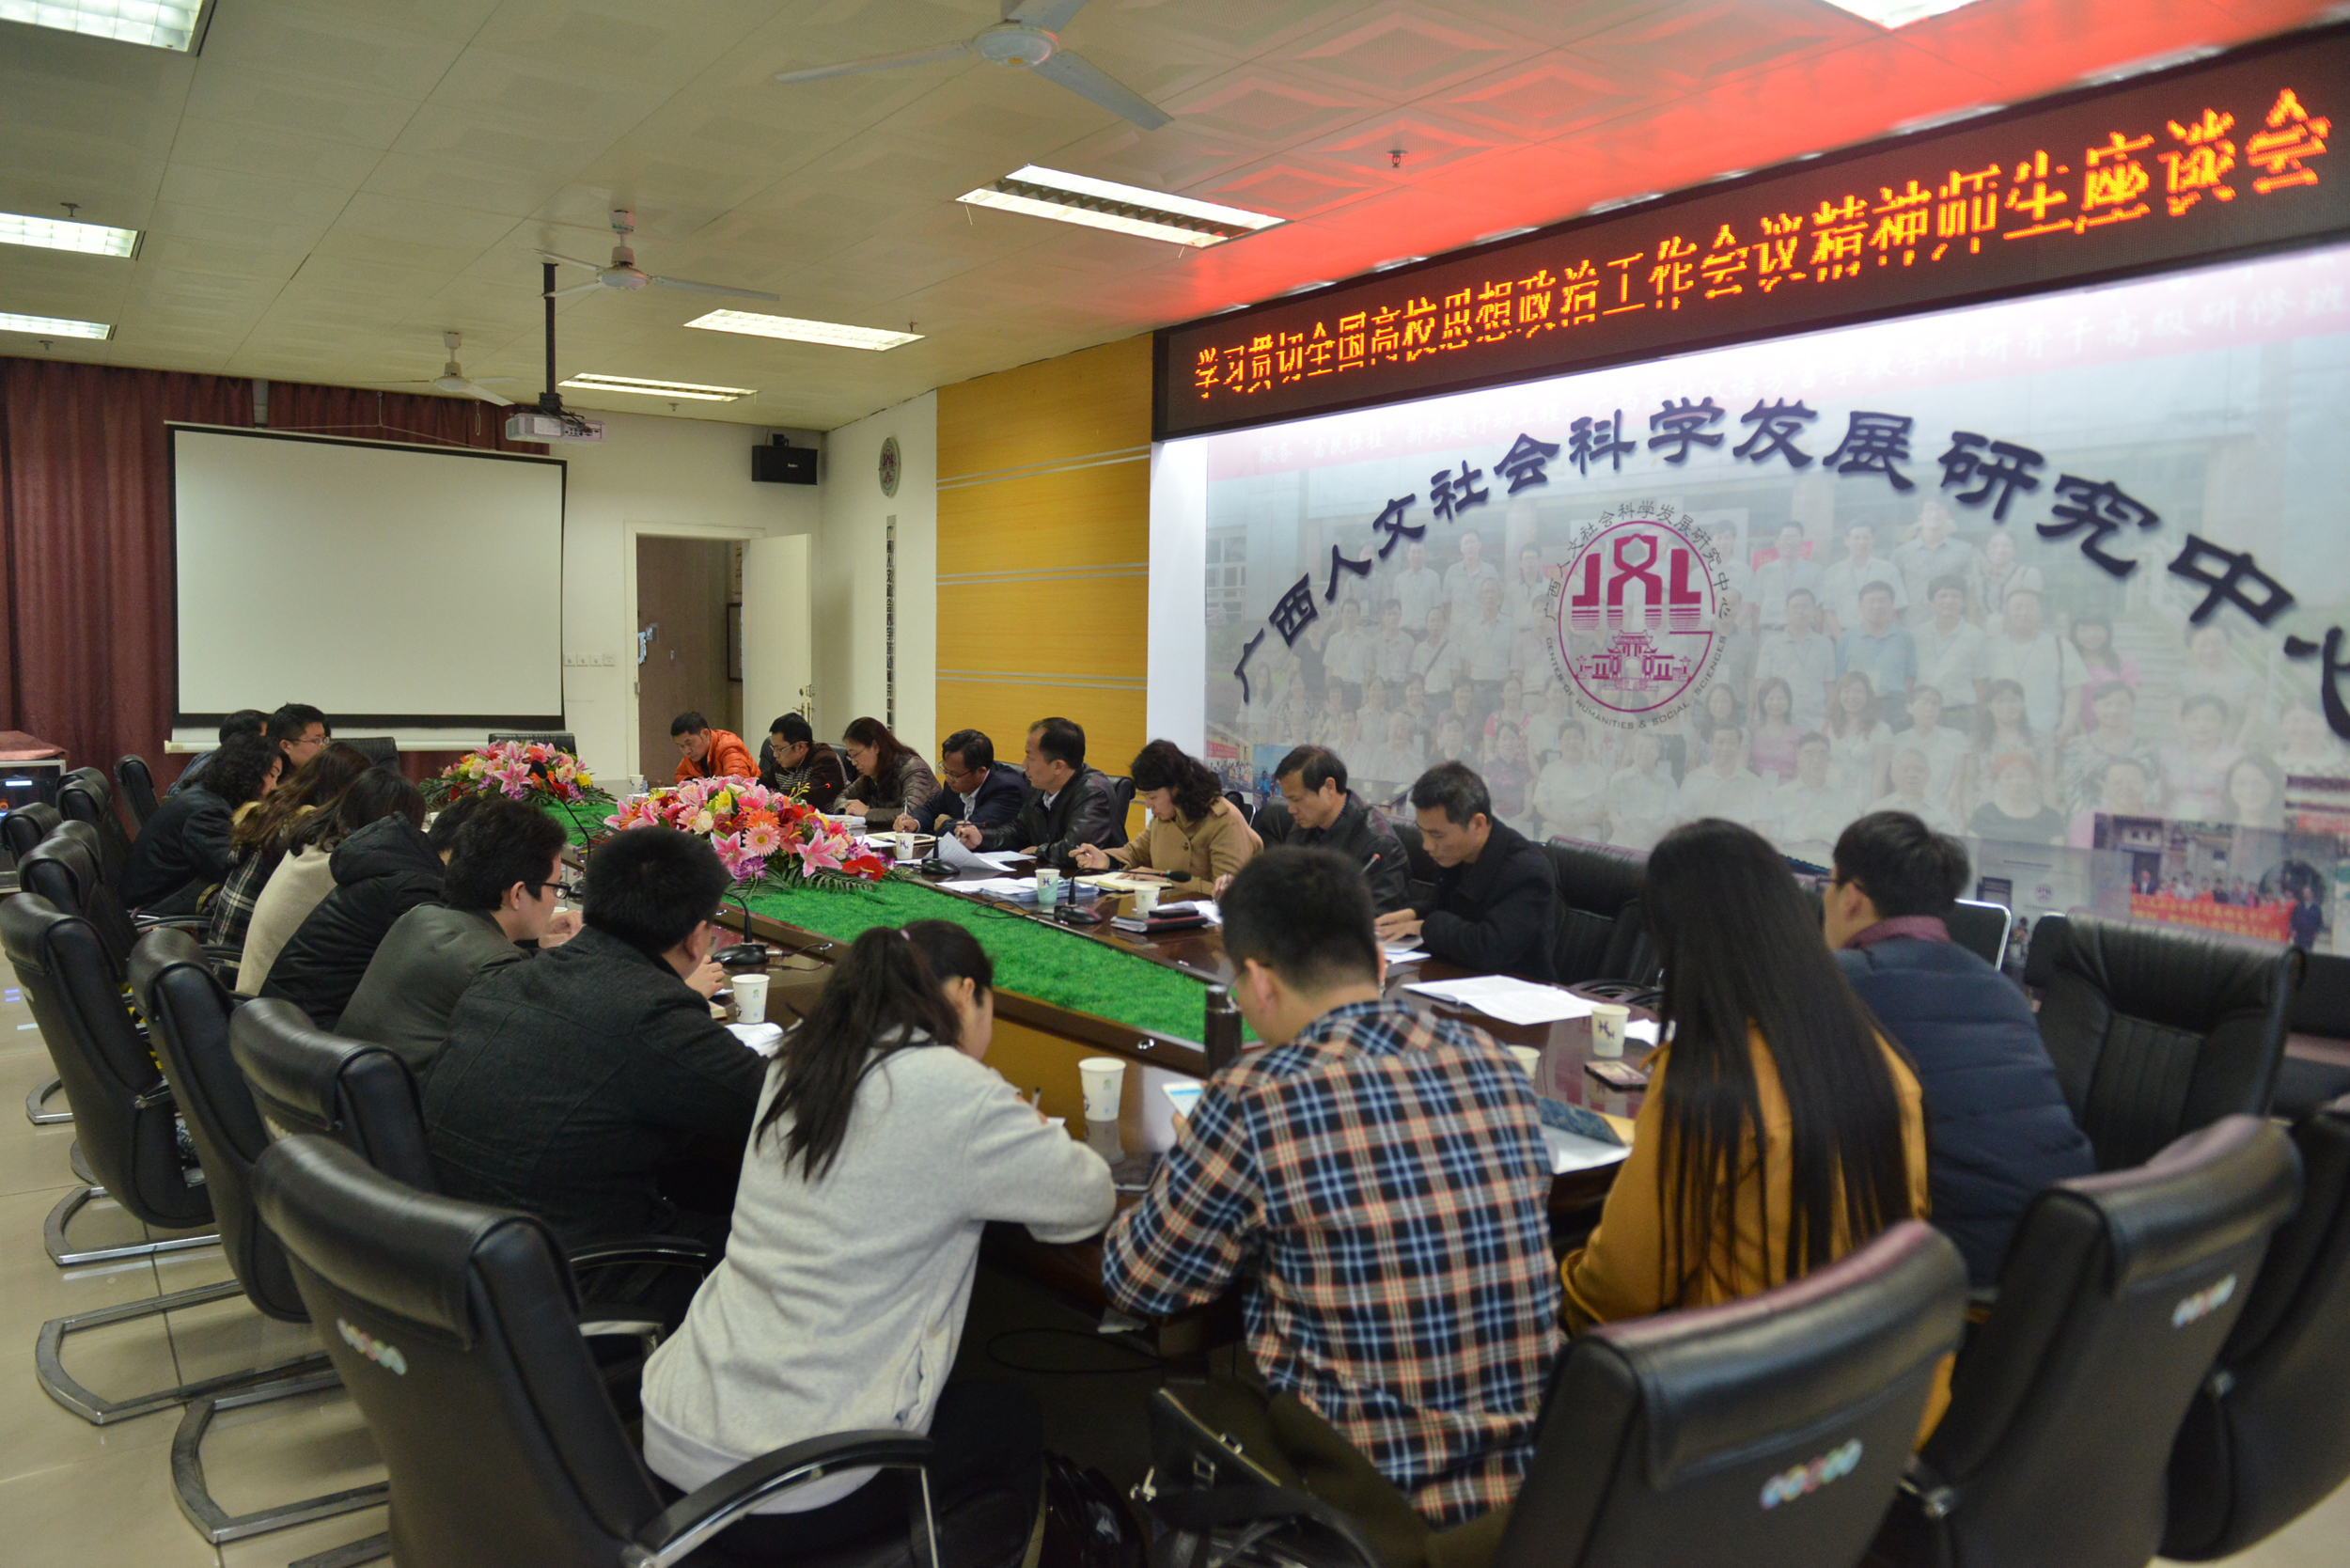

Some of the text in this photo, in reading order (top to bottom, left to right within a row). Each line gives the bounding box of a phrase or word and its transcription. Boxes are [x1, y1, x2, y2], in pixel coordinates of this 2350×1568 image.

[1546, 635, 1727, 729] CENTER OF HUMANITIES & SOCIAL SCIENCES
